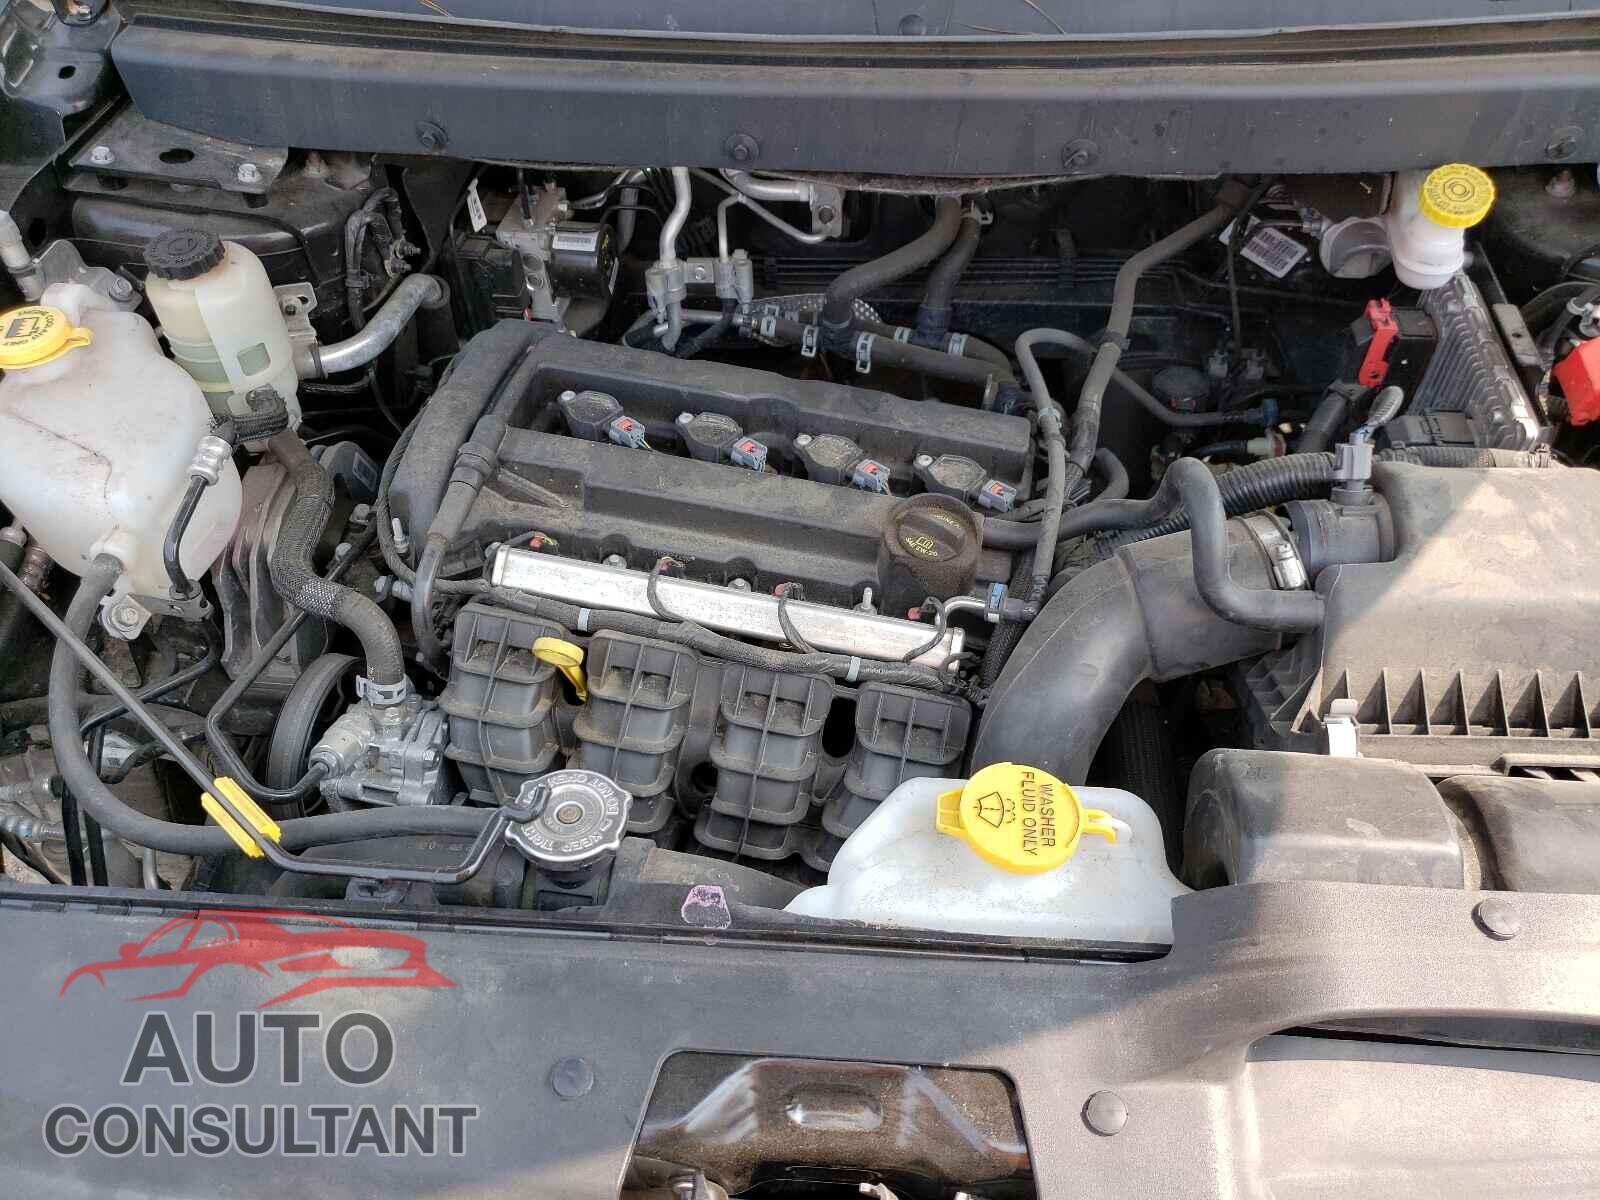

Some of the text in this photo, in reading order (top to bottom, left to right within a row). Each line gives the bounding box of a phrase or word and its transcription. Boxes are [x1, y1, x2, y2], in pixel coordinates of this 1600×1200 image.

[561, 831, 603, 853] KEEP
[1021, 771, 1038, 856] FLUID ONLY
[1039, 783, 1056, 848] WASHER
